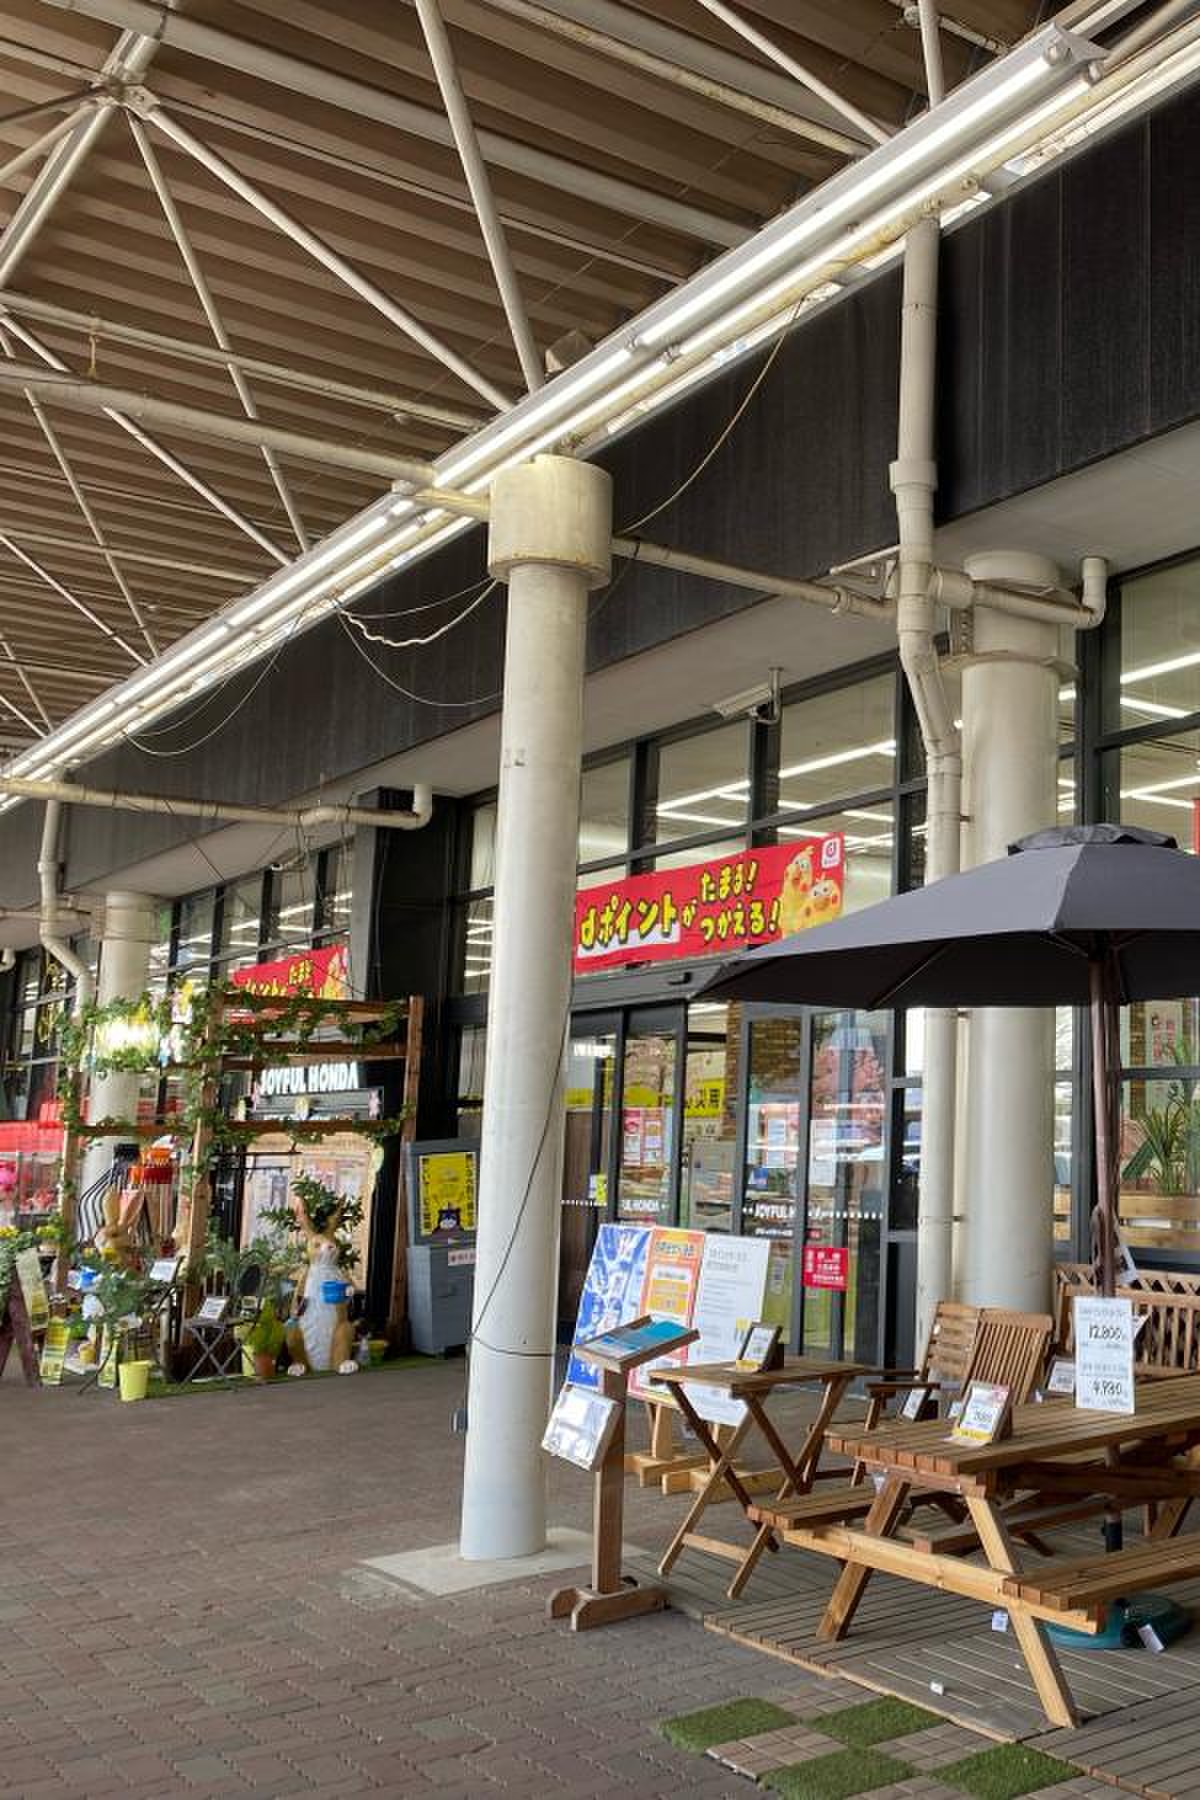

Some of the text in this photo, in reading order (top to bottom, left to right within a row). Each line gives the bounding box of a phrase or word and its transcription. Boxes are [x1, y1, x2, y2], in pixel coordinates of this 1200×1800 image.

[702, 861, 758, 902] たまる!
[700, 899, 783, 941] つかえる!
[259, 1060, 360, 1095] JOYFUL HONDA
